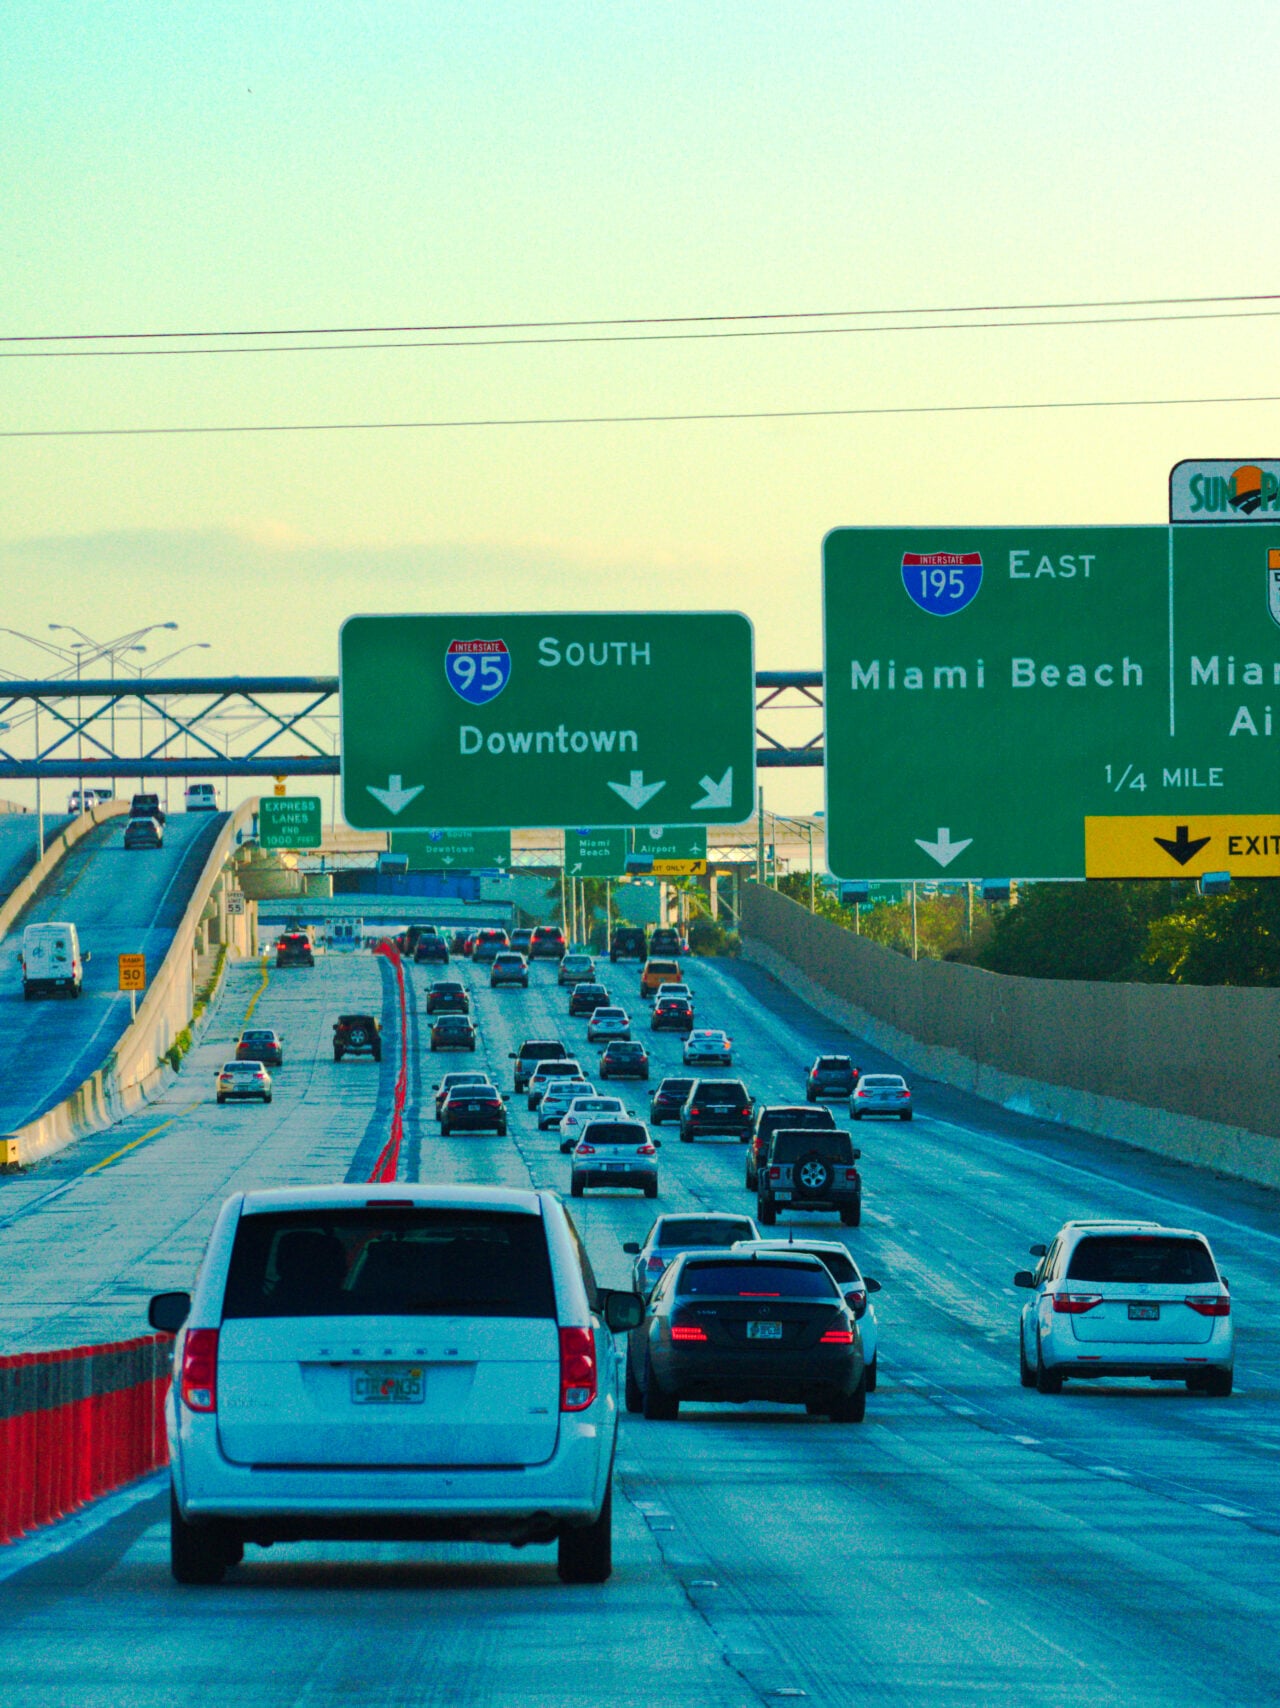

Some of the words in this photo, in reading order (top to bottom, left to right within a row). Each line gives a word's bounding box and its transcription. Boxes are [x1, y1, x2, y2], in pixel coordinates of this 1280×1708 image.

[920, 555, 964, 565] INTERSTATE
[1009, 550, 1096, 578] EAST
[920, 569, 965, 598] 195
[455, 643, 500, 652] INTERSTATE
[538, 637, 651, 667] SOUTH
[453, 655, 503, 691] 95
[851, 658, 984, 690] Miami
[1012, 656, 1143, 688] Beach
[460, 724, 638, 754] Downtown
[1104, 764, 1148, 792] 1/4
[1163, 767, 1224, 788] MILE
[265, 801, 315, 812] EXPRESS
[272, 814, 309, 824] LANES
[426, 845, 475, 853] Downtown
[580, 848, 610, 856] Beach
[641, 845, 676, 853] Airport
[124, 969, 140, 980] 50
